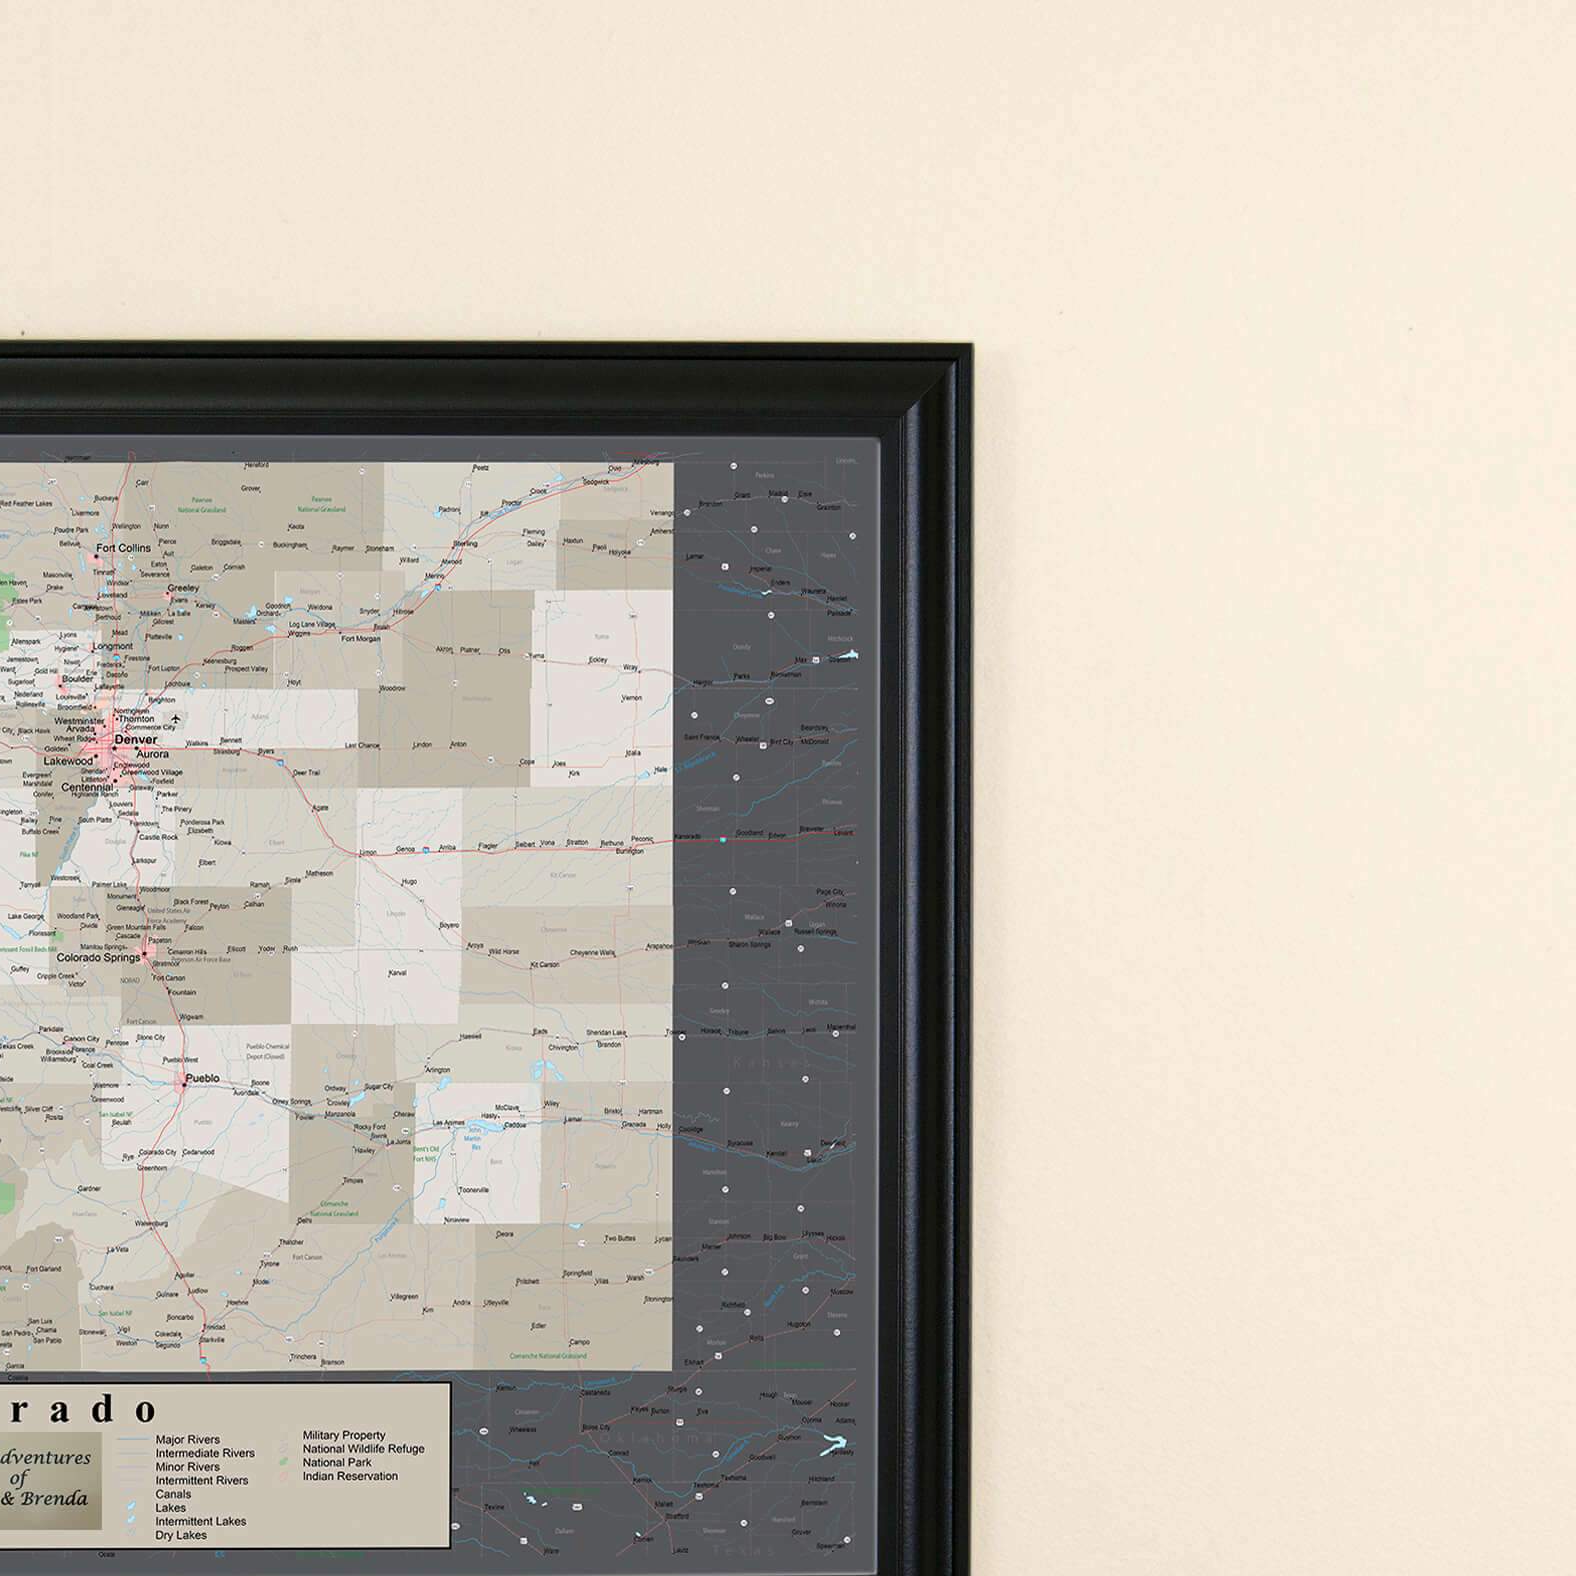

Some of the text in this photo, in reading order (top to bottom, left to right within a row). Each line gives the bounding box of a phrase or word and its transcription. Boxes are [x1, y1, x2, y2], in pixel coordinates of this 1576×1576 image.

[97, 544, 151, 552] Fort Collins
[168, 584, 199, 594] Greeley
[93, 643, 133, 651] Longmont
[62, 675, 93, 683] Boulder
[54, 717, 104, 725] Westminster
[119, 715, 154, 723] Thornton
[67, 725, 95, 733] Arvada
[115, 735, 158, 744] Denver
[137, 749, 169, 758] Aurora
[44, 757, 93, 765] Lakewood
[61, 783, 113, 792] Centennial
[57, 953, 140, 963] Colorado Springs
[186, 1074, 220, 1082] Pueblo
[156, 1435, 220, 1446] Major Rivers
[303, 1430, 386, 1442] Military Property
[156, 1448, 255, 1458] Intermediate Rivers
[303, 1444, 425, 1455] National Wildlife Refuge
[156, 1462, 220, 1471] Minor Rivers
[303, 1458, 371, 1467] National Park
[10, 1469, 30, 1490] of
[156, 1476, 248, 1485] Intermittent Rivers
[304, 1471, 398, 1481] Indian Reservation
[1, 1492, 14, 1505] &
[21, 1490, 88, 1505] Brenda
[156, 1489, 191, 1499] Canals
[156, 1503, 186, 1512] Lakes
[156, 1517, 246, 1526] Intermittent Lakes
[156, 1530, 207, 1542] Dry Lakes
